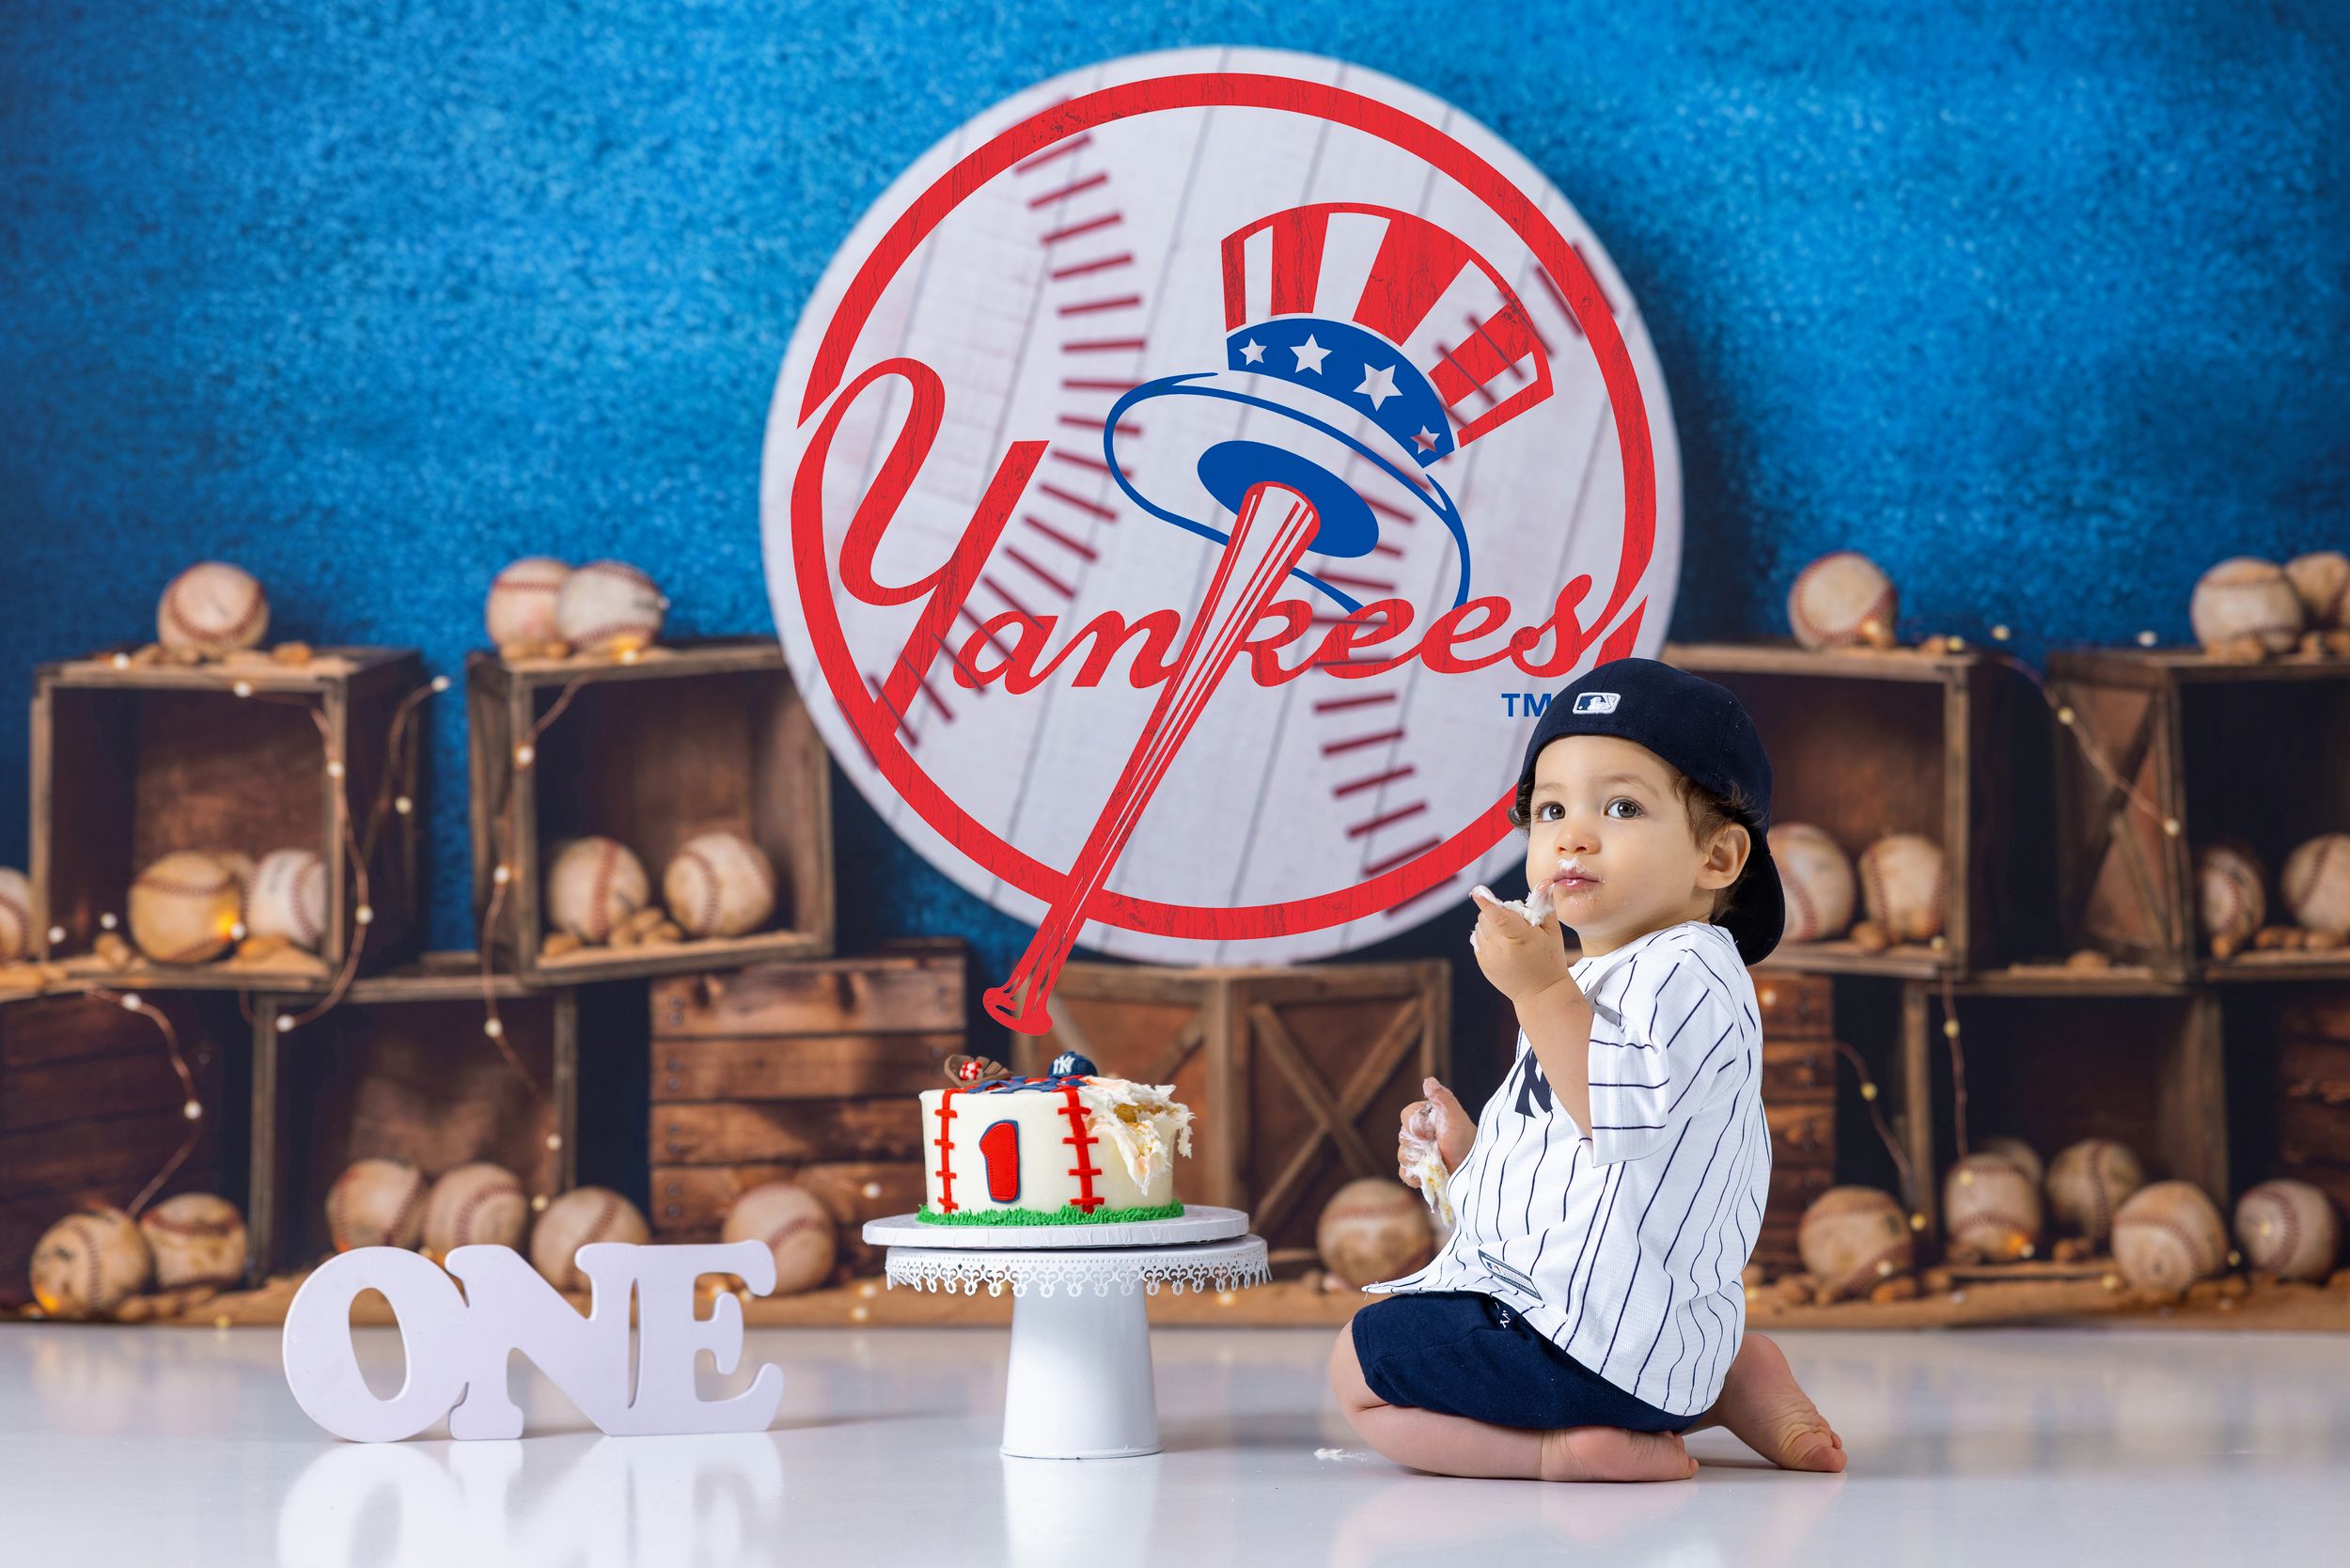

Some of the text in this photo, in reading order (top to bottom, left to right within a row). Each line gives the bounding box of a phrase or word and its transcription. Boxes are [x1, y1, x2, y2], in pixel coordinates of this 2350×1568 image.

[837, 357, 1592, 737] Yankees
[1501, 693, 1552, 717] TM
[1053, 1055, 1076, 1074] NY
[979, 1119, 1020, 1203] 1
[283, 1239, 784, 1443] ONE
